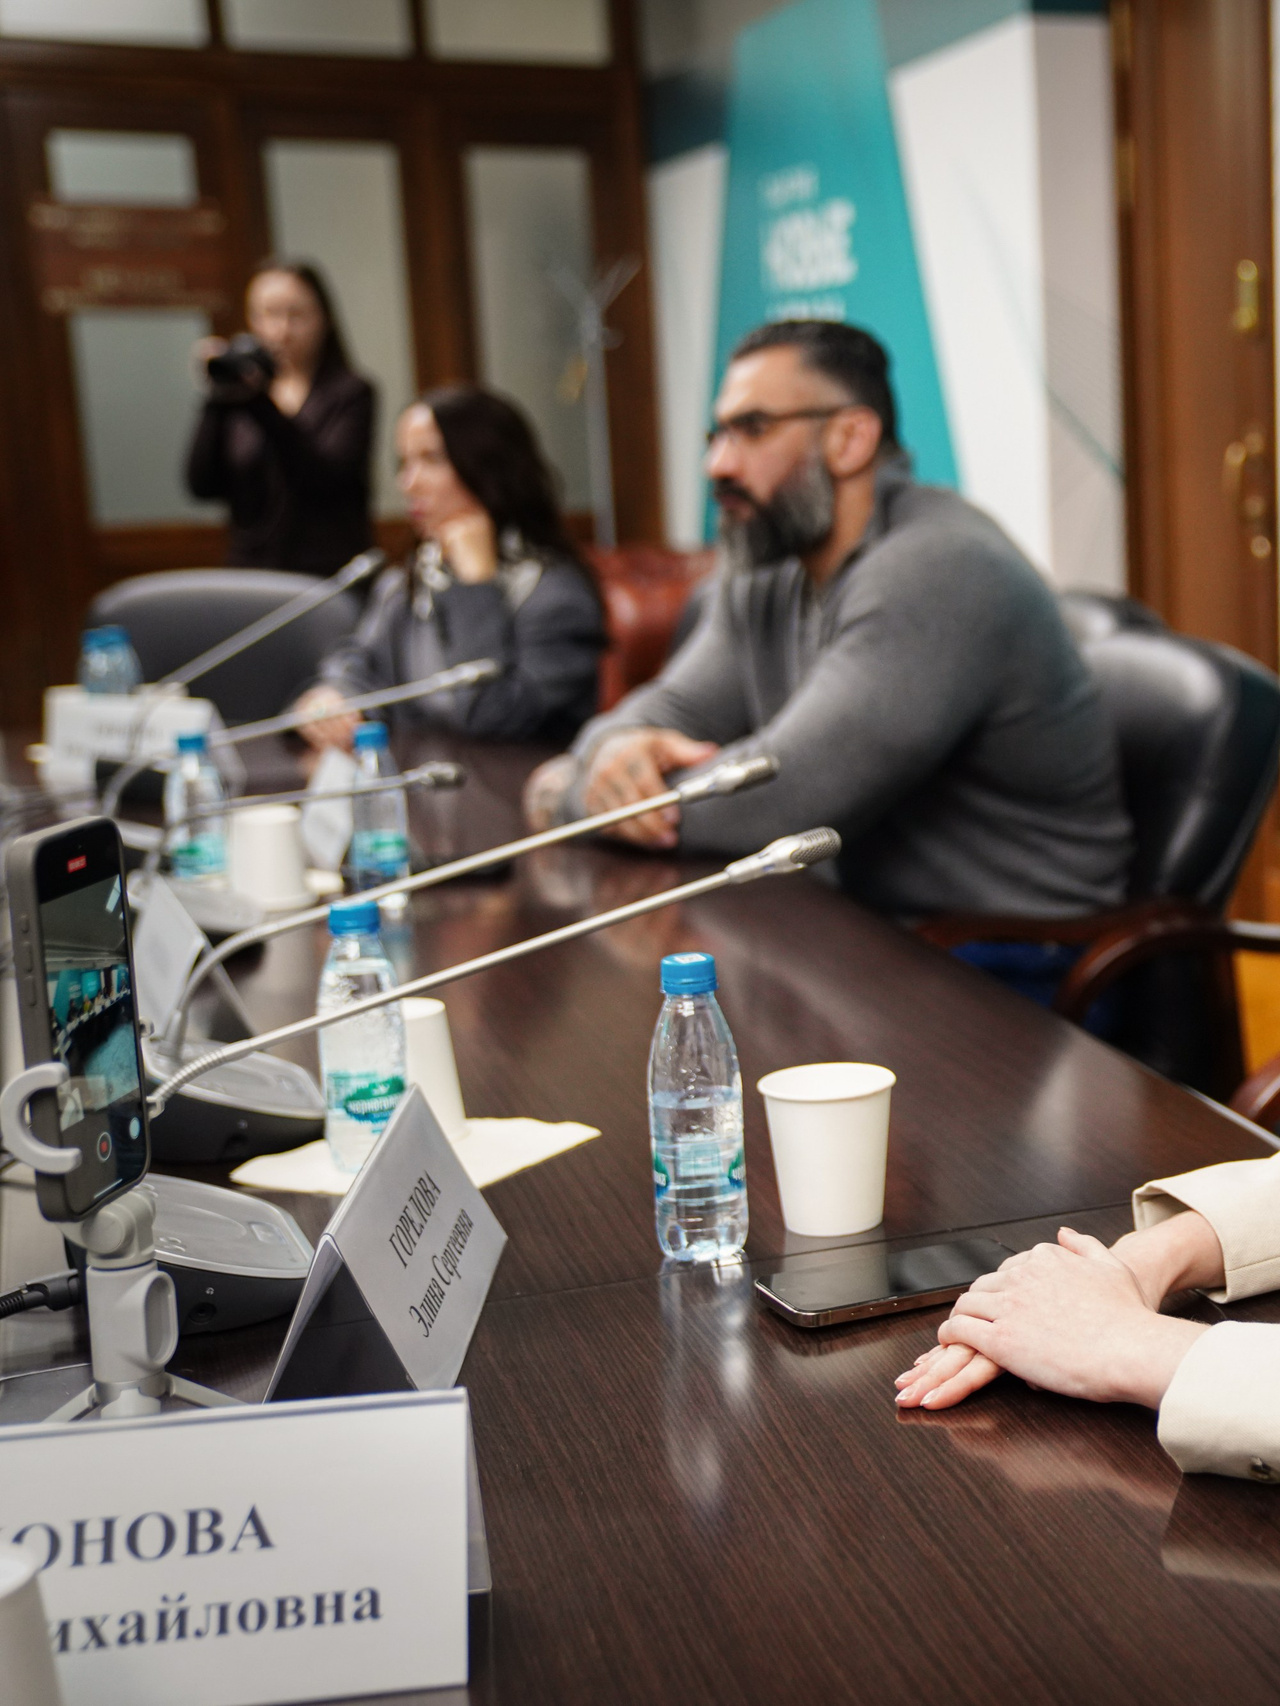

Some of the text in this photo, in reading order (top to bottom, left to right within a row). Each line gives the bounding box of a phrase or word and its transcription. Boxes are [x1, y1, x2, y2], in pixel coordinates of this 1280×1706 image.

[388, 1168, 442, 1269] ГОРЕЛОВА
[408, 1207, 474, 1338] Элина Сергеевна
[0, 1503, 276, 1573] ОНОВА
[50, 1585, 382, 1653] ихайловна
